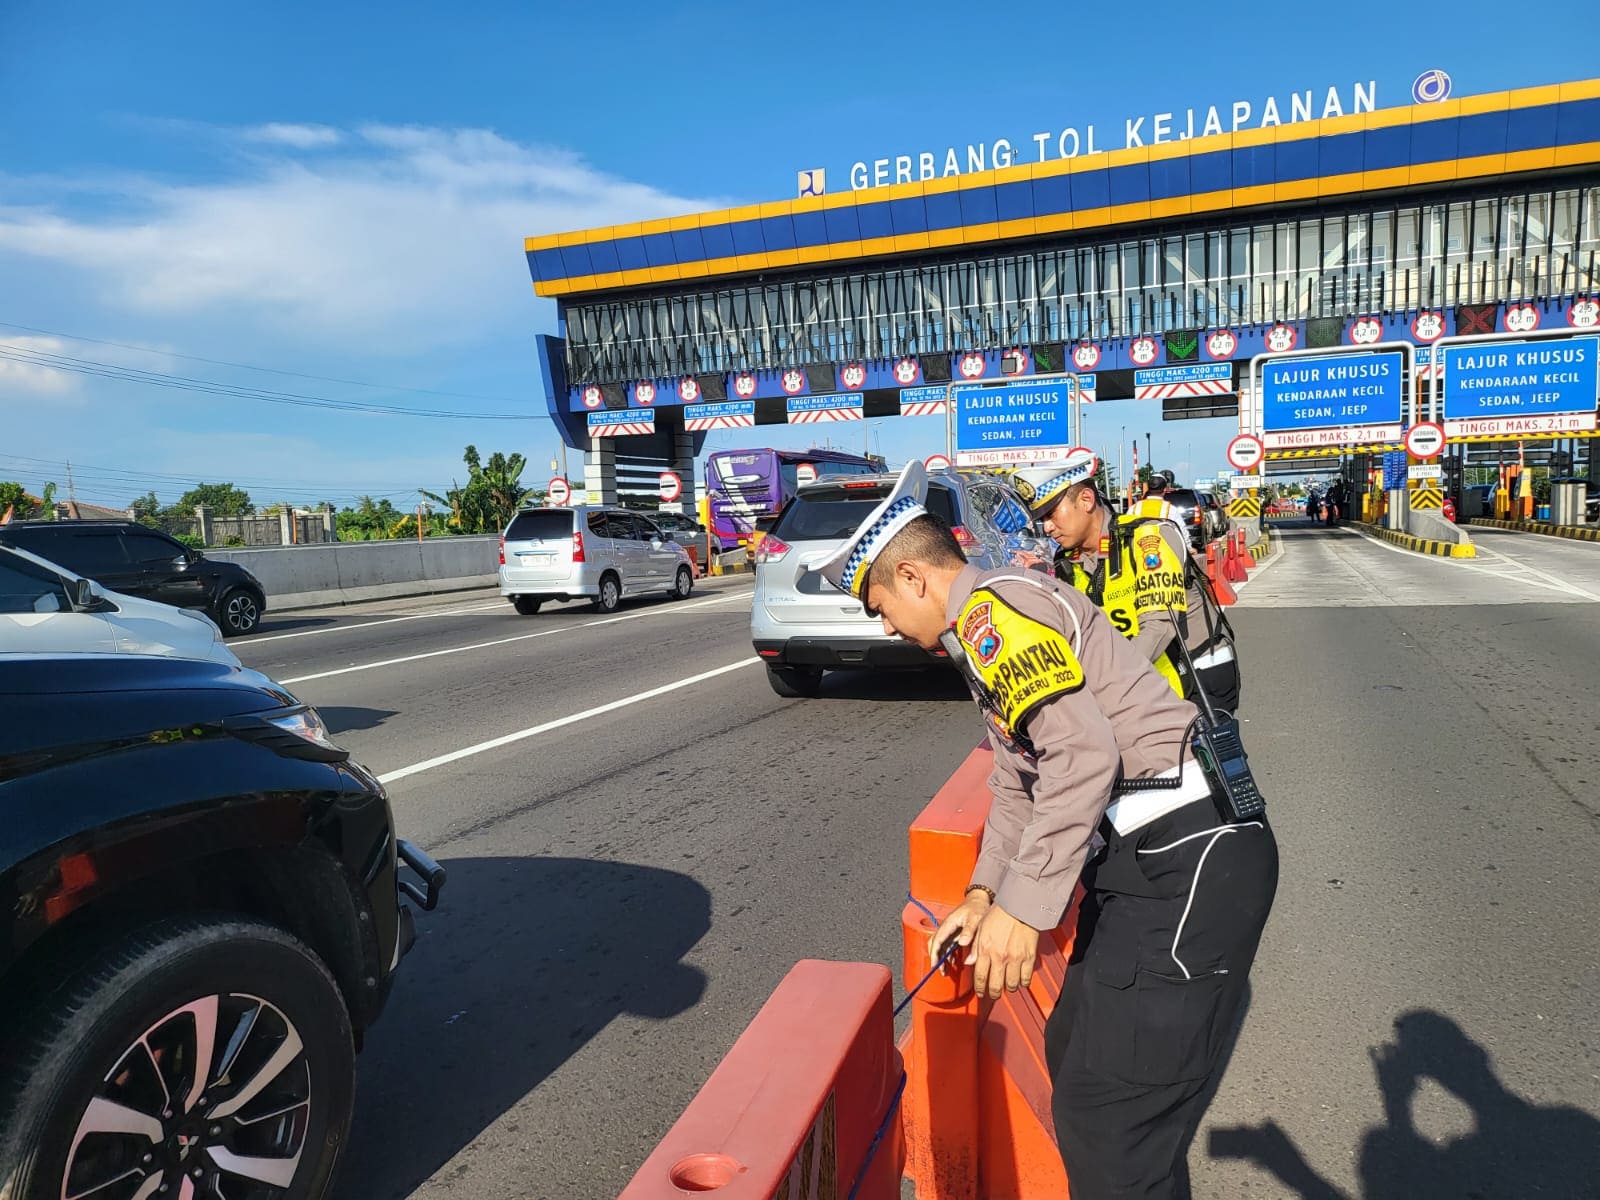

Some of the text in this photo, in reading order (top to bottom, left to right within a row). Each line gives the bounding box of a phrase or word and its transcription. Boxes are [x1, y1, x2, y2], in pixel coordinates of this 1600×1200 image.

[850, 80, 1376, 190] GERBANG TOL KEJAPANAN
[1457, 348, 1585, 370] LAJUR KHUSUS
[1139, 370, 1164, 378] TINGGI
[1166, 368, 1189, 376] MAKS.
[1191, 366, 1210, 374] 4200
[1273, 363, 1390, 385] LAJUR KHUSUS
[1460, 372, 1580, 389] KENDARAAN KECIL
[965, 391, 1059, 409] LAJUR KHUSUS
[1277, 385, 1385, 403] KENDARAAN KECIL
[1479, 392, 1561, 407] SEDAN, JEEP
[968, 411, 1056, 426] KENDARAAN KECIL
[1294, 405, 1368, 419] SEDAN, JEEP
[1459, 418, 1579, 433] TINGGI MAKS. 2,1 m
[981, 429, 1042, 441] SEDAN, JEEP
[1277, 430, 1386, 445] TINGGI MAKS. 2,1 m
[968, 453, 999, 463] TINGGI
[1003, 451, 1031, 461] MAKS.
[1053, 670, 1076, 684] 2023
